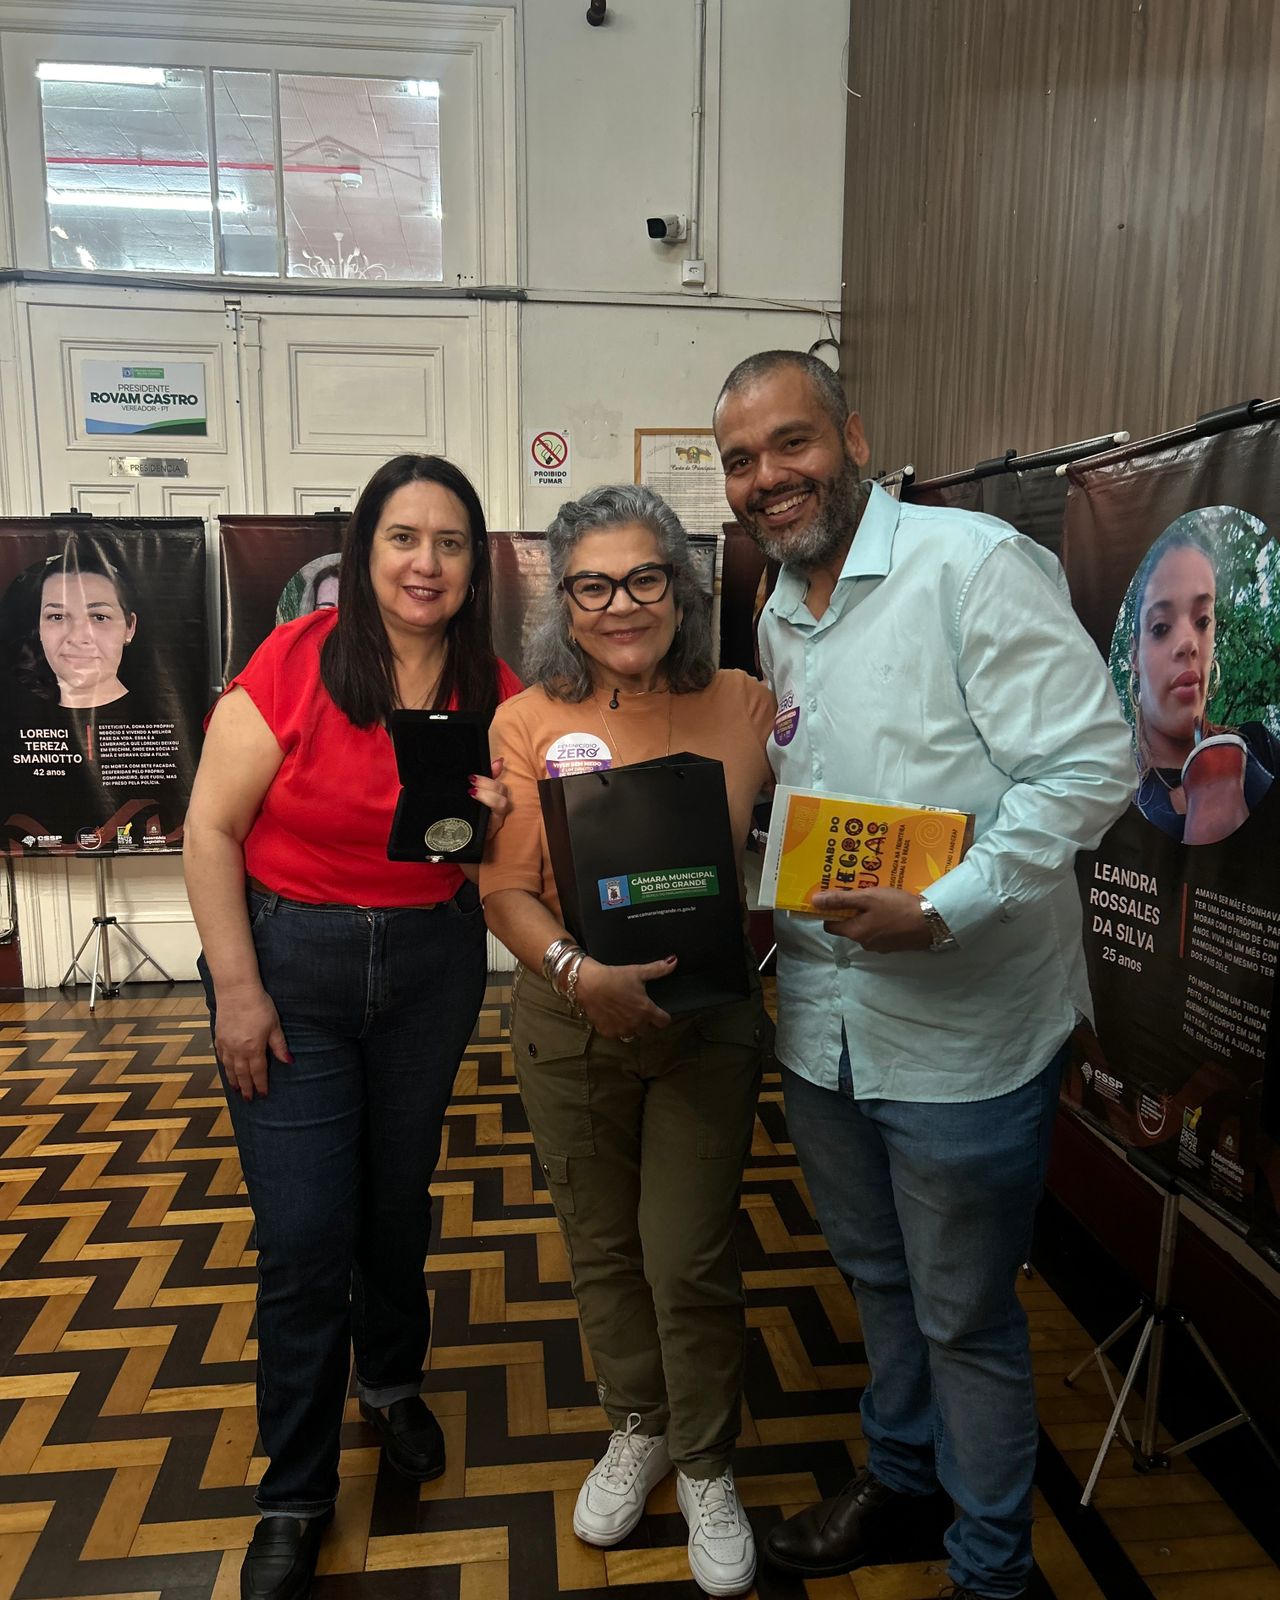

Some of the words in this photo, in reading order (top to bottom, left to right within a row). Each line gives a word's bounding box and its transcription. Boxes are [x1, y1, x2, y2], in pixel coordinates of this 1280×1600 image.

[90, 392, 140, 404] ROVAM
[143, 394, 198, 405] CASTRO
[118, 384, 170, 392] PRESIDENTE
[20, 729, 68, 738] LORENCI
[13, 754, 82, 763] SMANIOTTO
[25, 742, 68, 751] TEREZA
[557, 748, 600, 759] ZERO
[820, 838, 837, 891] UILOMBO
[830, 816, 840, 833] DO
[858, 822, 889, 889] UCAS
[631, 876, 667, 886] CÂMARA
[669, 871, 714, 880] MUNICIPAL
[672, 879, 707, 888] GRANDE
[1094, 862, 1158, 896] LEANDRA
[1090, 888, 1161, 925] ROSSALES
[1195, 888, 1217, 901] AMAVA
[1219, 894, 1228, 904] SER
[1229, 898, 1241, 910] MÃE
[1242, 903, 1246, 912] E
[627, 906, 696, 919] www.camarariogrande.rs.gov.br
[1195, 900, 1206, 910] TER
[1208, 904, 1219, 915] UMA
[1221, 909, 1234, 922] CASA
[1236, 915, 1265, 933] PRÓPRIA,
[1092, 915, 1112, 937] DA
[1116, 923, 1154, 953] SILVA
[1194, 913, 1214, 926] MORAR
[1215, 921, 1227, 931] COM
[1233, 928, 1250, 941] FILHO
[1252, 934, 1261, 944] DE
[1212, 932, 1225, 944] VIVIA
[1226, 938, 1233, 948] HÁ
[1234, 943, 1244, 952] UM
[1245, 947, 1261, 958] MÊS
[1102, 946, 1116, 962] 25
[1118, 954, 1142, 973] anos
[1191, 950, 1202, 961] DOS
[1204, 956, 1214, 967] PAIS
[1224, 951, 1232, 961] NO
[1233, 955, 1258, 971] MESMO
[1188, 974, 1198, 986] FOI
[1198, 980, 1215, 995] MORTA
[1216, 989, 1229, 1002] COM
[1230, 996, 1241, 1007] UM
[1242, 1000, 1259, 1014] TIRO
[1185, 1000, 1208, 1018] QUEIMOU
[1209, 1012, 1213, 1020] O
[1214, 1015, 1235, 1031] CORPO
[1236, 1026, 1247, 1037] EM
[1248, 1031, 1260, 1043] UM
[1204, 996, 1208, 1004] O
[1209, 998, 1242, 1021] NAMORADO
[1244, 1016, 1266, 1032] AINDA
[1196, 1032, 1204, 1042] EM
[1210, 1027, 1224, 1040] COM
[1225, 1035, 1230, 1043] A
[1231, 1037, 1255, 1055] AJUDA
[1094, 1070, 1123, 1089] CSSP
